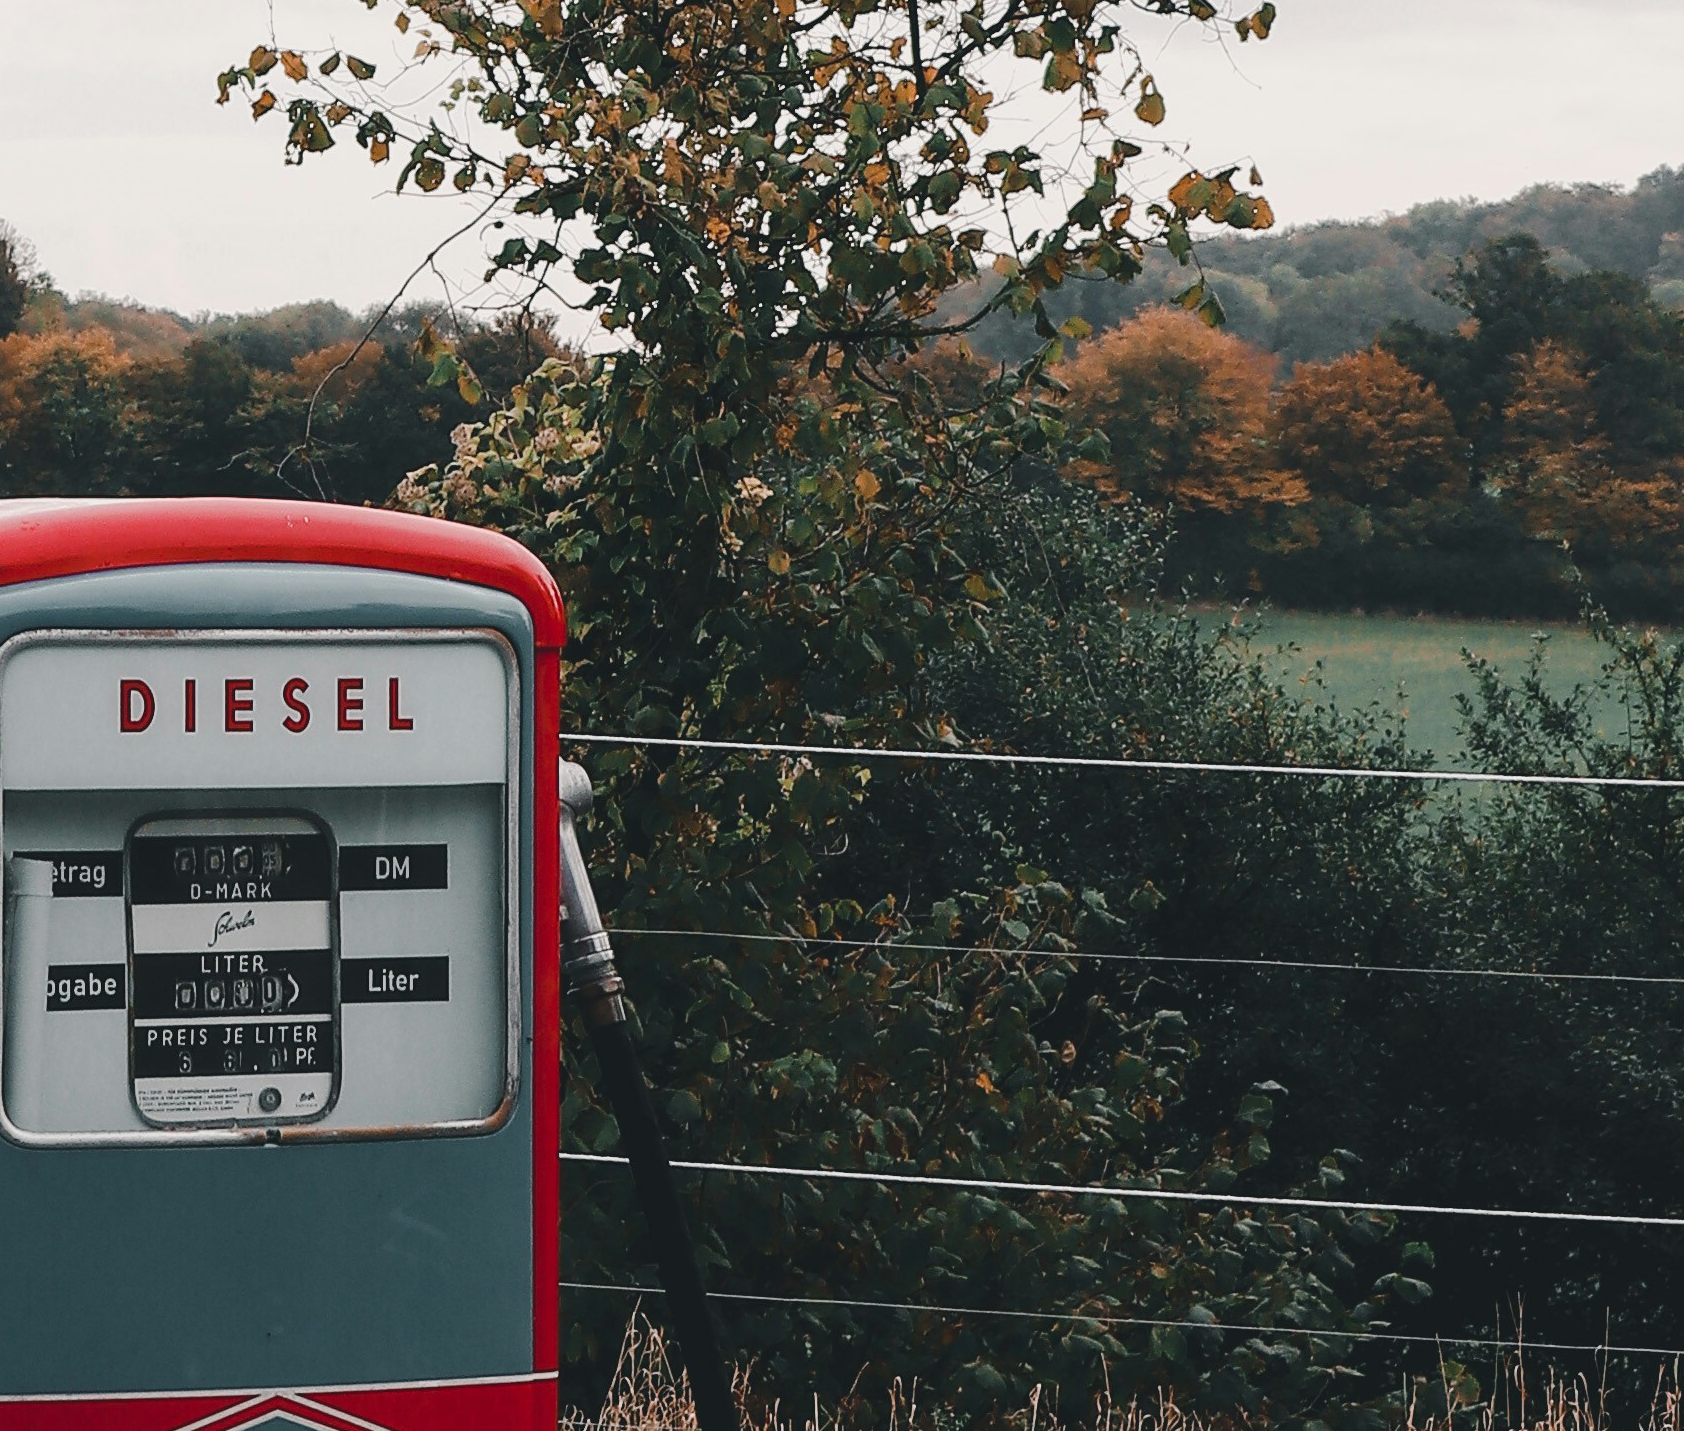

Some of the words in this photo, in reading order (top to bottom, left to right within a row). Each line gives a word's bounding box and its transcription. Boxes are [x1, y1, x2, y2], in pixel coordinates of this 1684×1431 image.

[119, 676, 414, 733] DIESEL
[52, 861, 105, 888] etrag
[375, 856, 410, 880] DM
[190, 882, 272, 900] D-MARK
[201, 954, 264, 974] LITER
[368, 968, 419, 992] Liter
[147, 1028, 208, 1046] PREIS
[222, 1026, 244, 1045] JE
[255, 1025, 317, 1044] LITER
